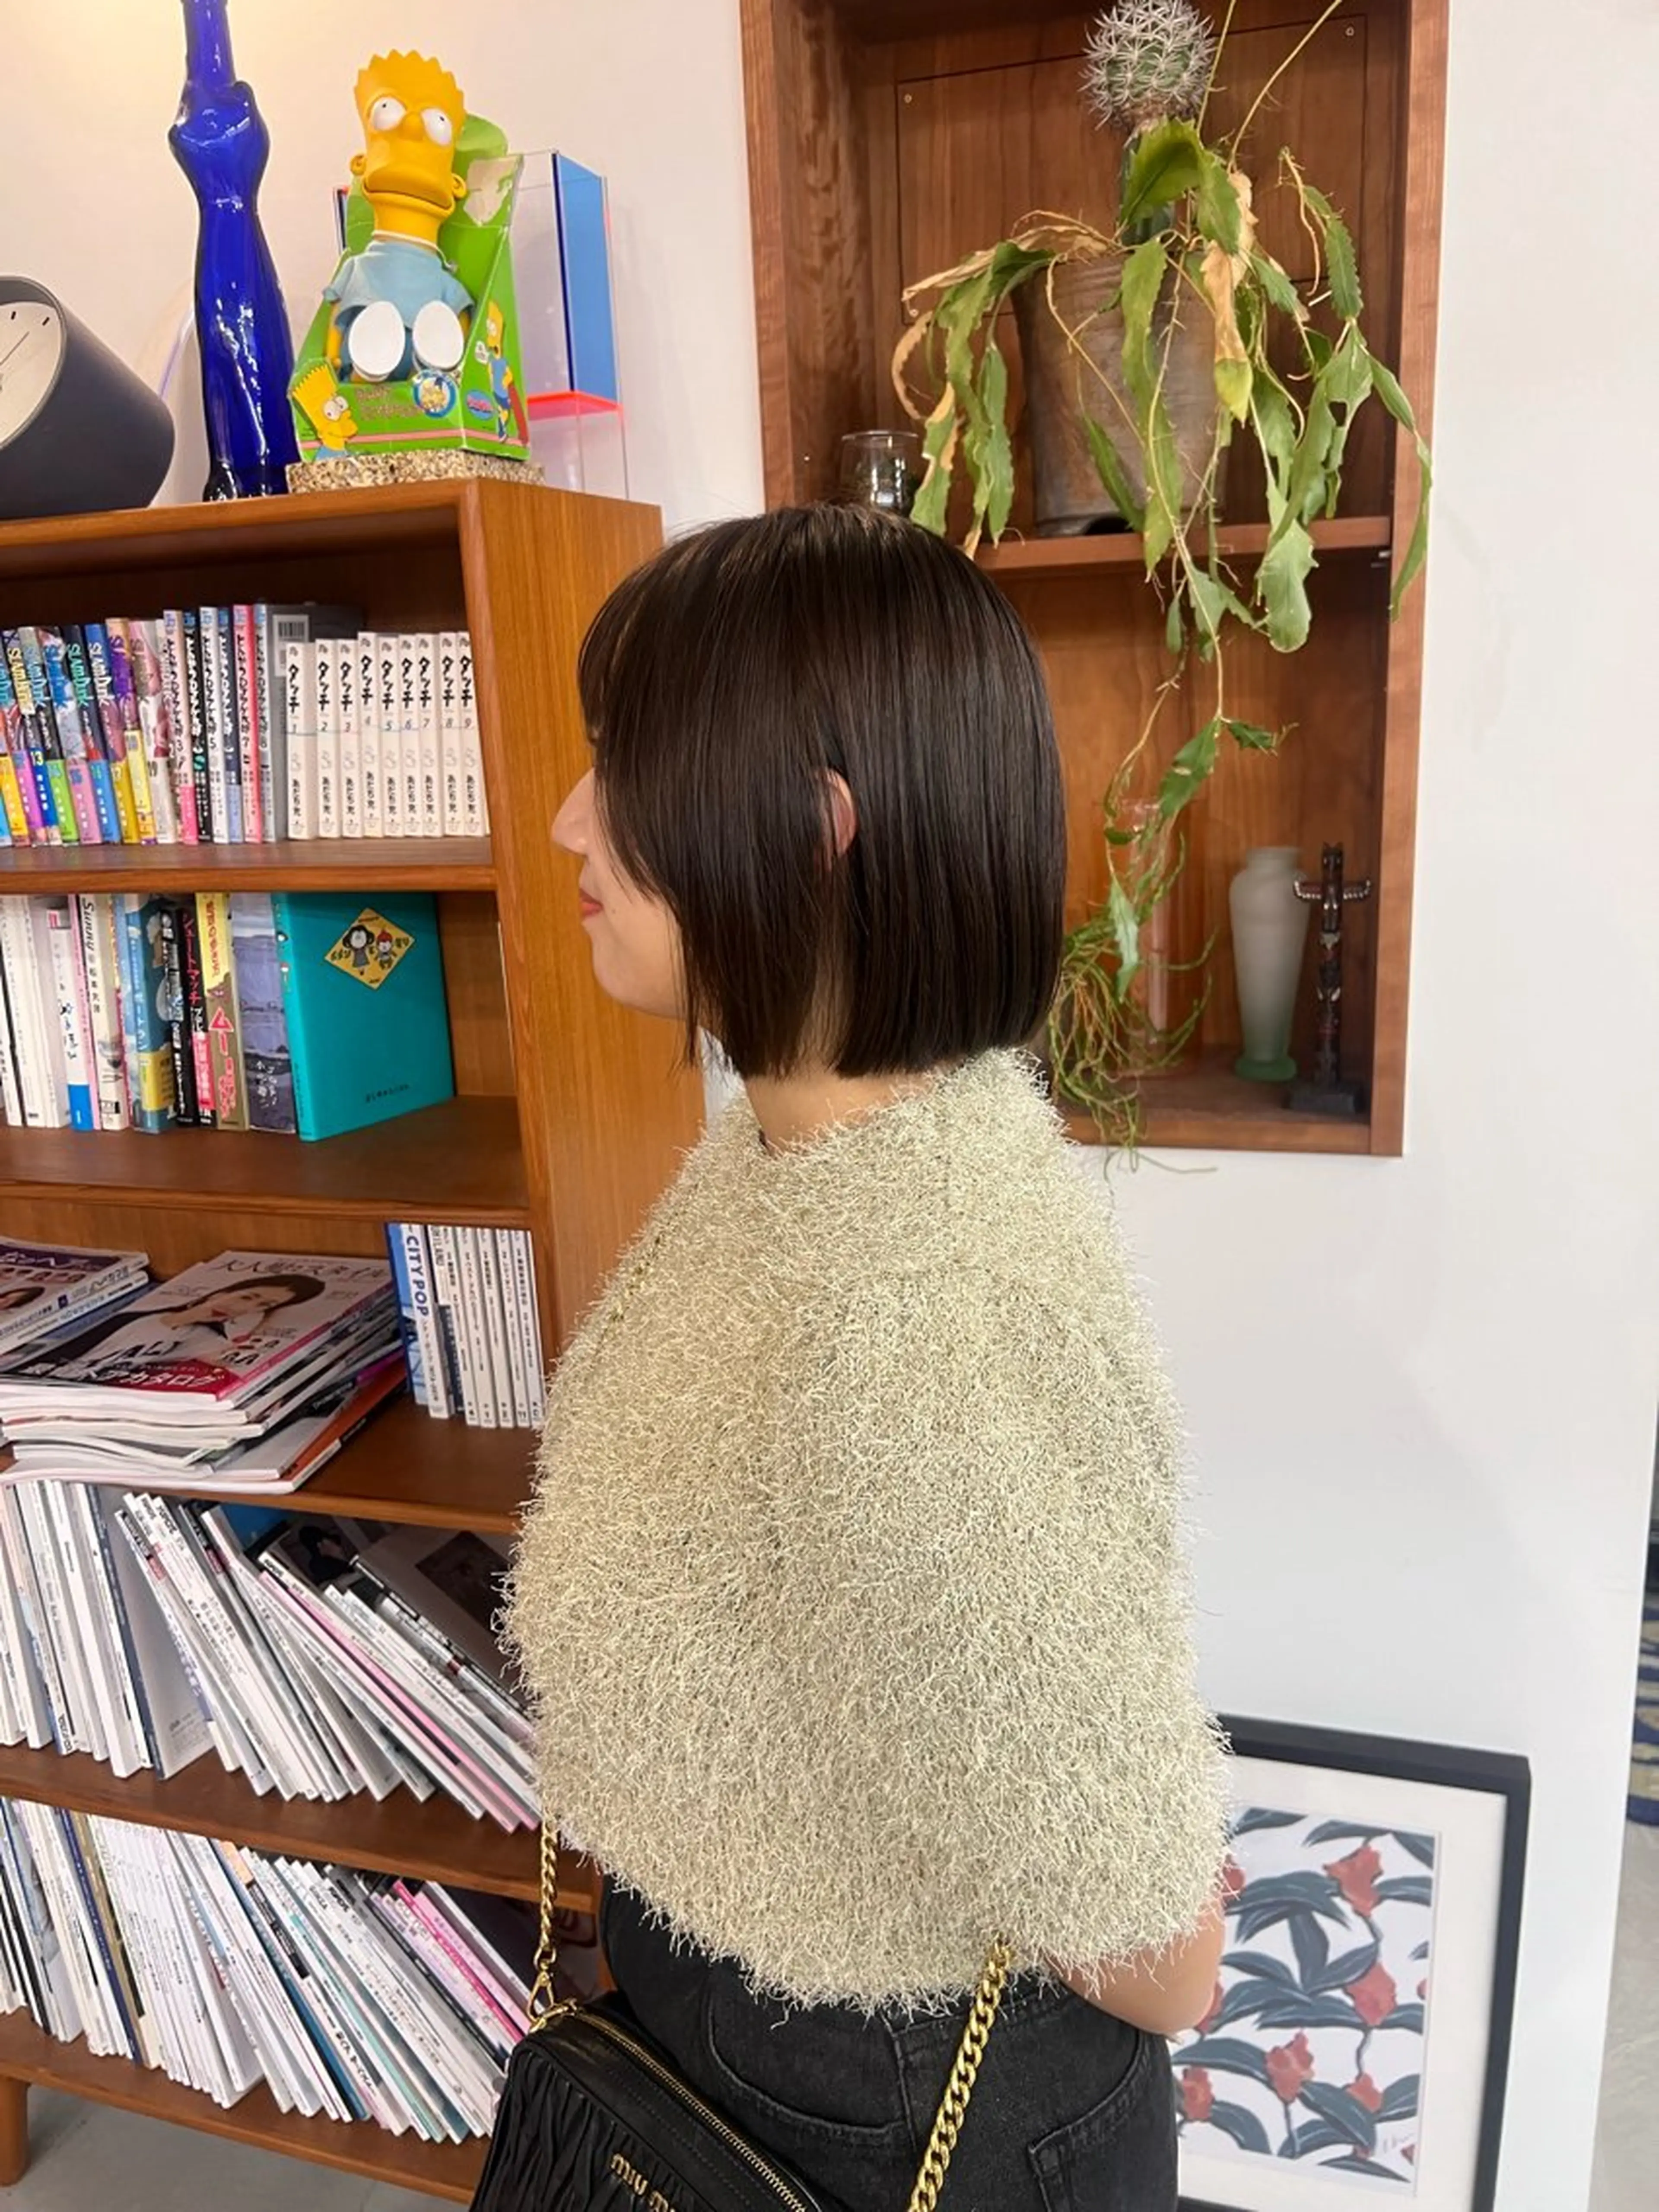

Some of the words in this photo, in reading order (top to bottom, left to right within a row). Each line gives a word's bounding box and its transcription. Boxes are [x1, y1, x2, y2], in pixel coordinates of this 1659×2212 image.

[289, 664, 299, 713] タッチ
[318, 661, 330, 711] タッチ
[340, 661, 352, 712] タッチ
[361, 654, 373, 705] タッチ
[381, 660, 394, 711] タッチ
[401, 657, 413, 709] タッチ
[419, 656, 432, 708] タッチ
[442, 655, 455, 707] タッチ
[460, 655, 473, 707] タッチ
[406, 1236, 424, 1276] CITY
[413, 1279, 429, 1316] POP
